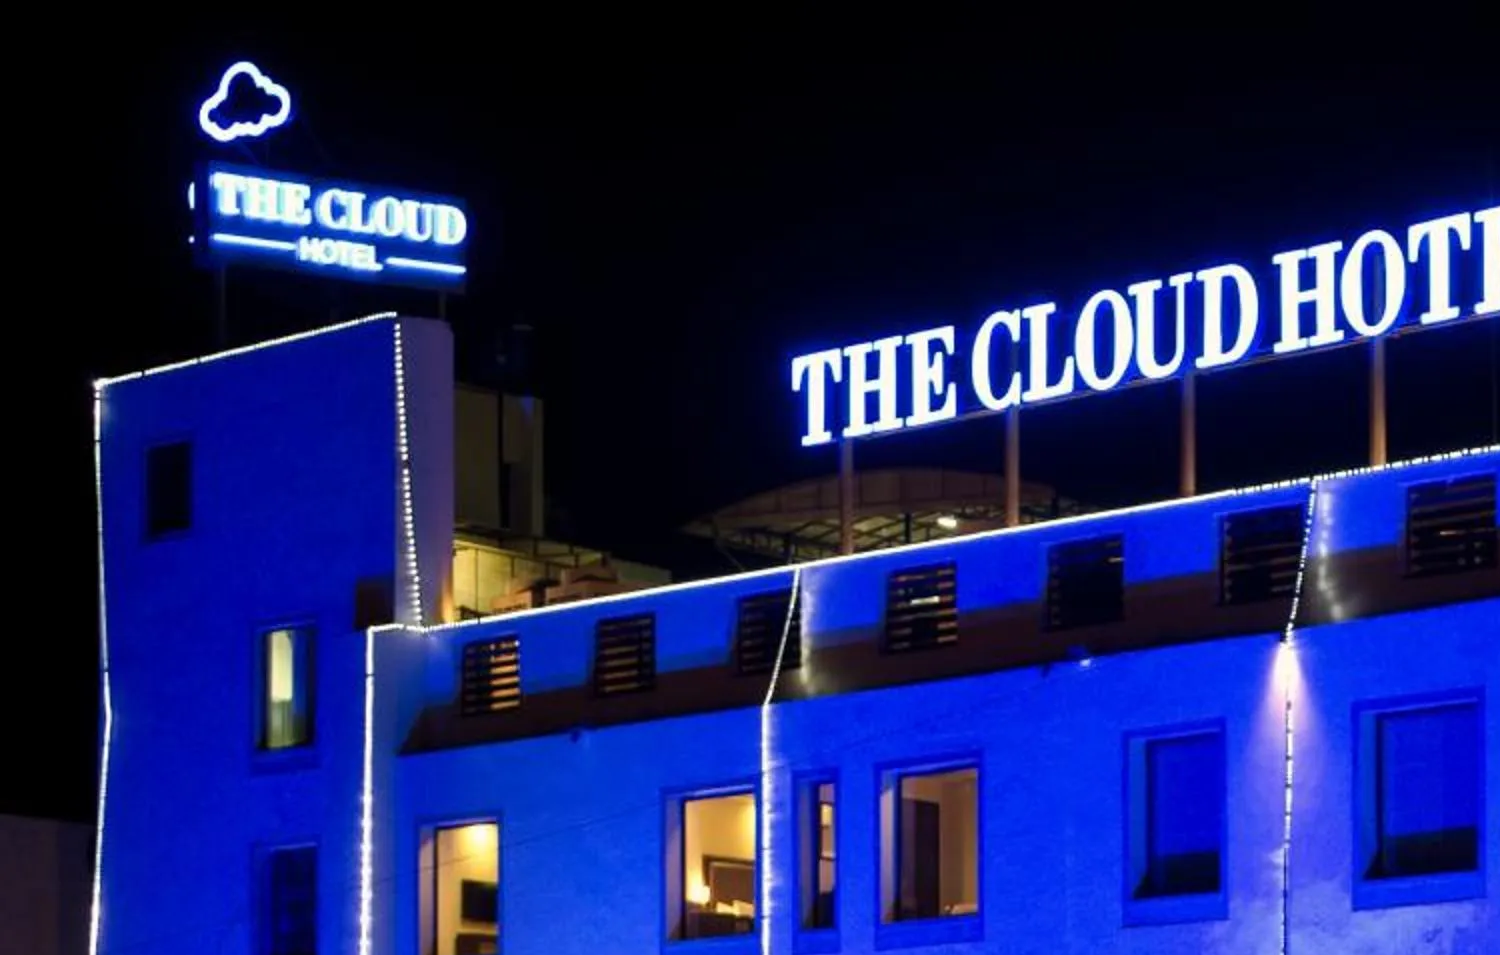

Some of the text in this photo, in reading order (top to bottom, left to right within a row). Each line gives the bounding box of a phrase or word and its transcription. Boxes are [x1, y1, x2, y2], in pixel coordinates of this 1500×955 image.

[211, 171, 467, 246] THE CLOUD
[296, 236, 383, 272] HOTEL
[791, 324, 957, 446] THE
[971, 263, 1259, 412] CLOUD
